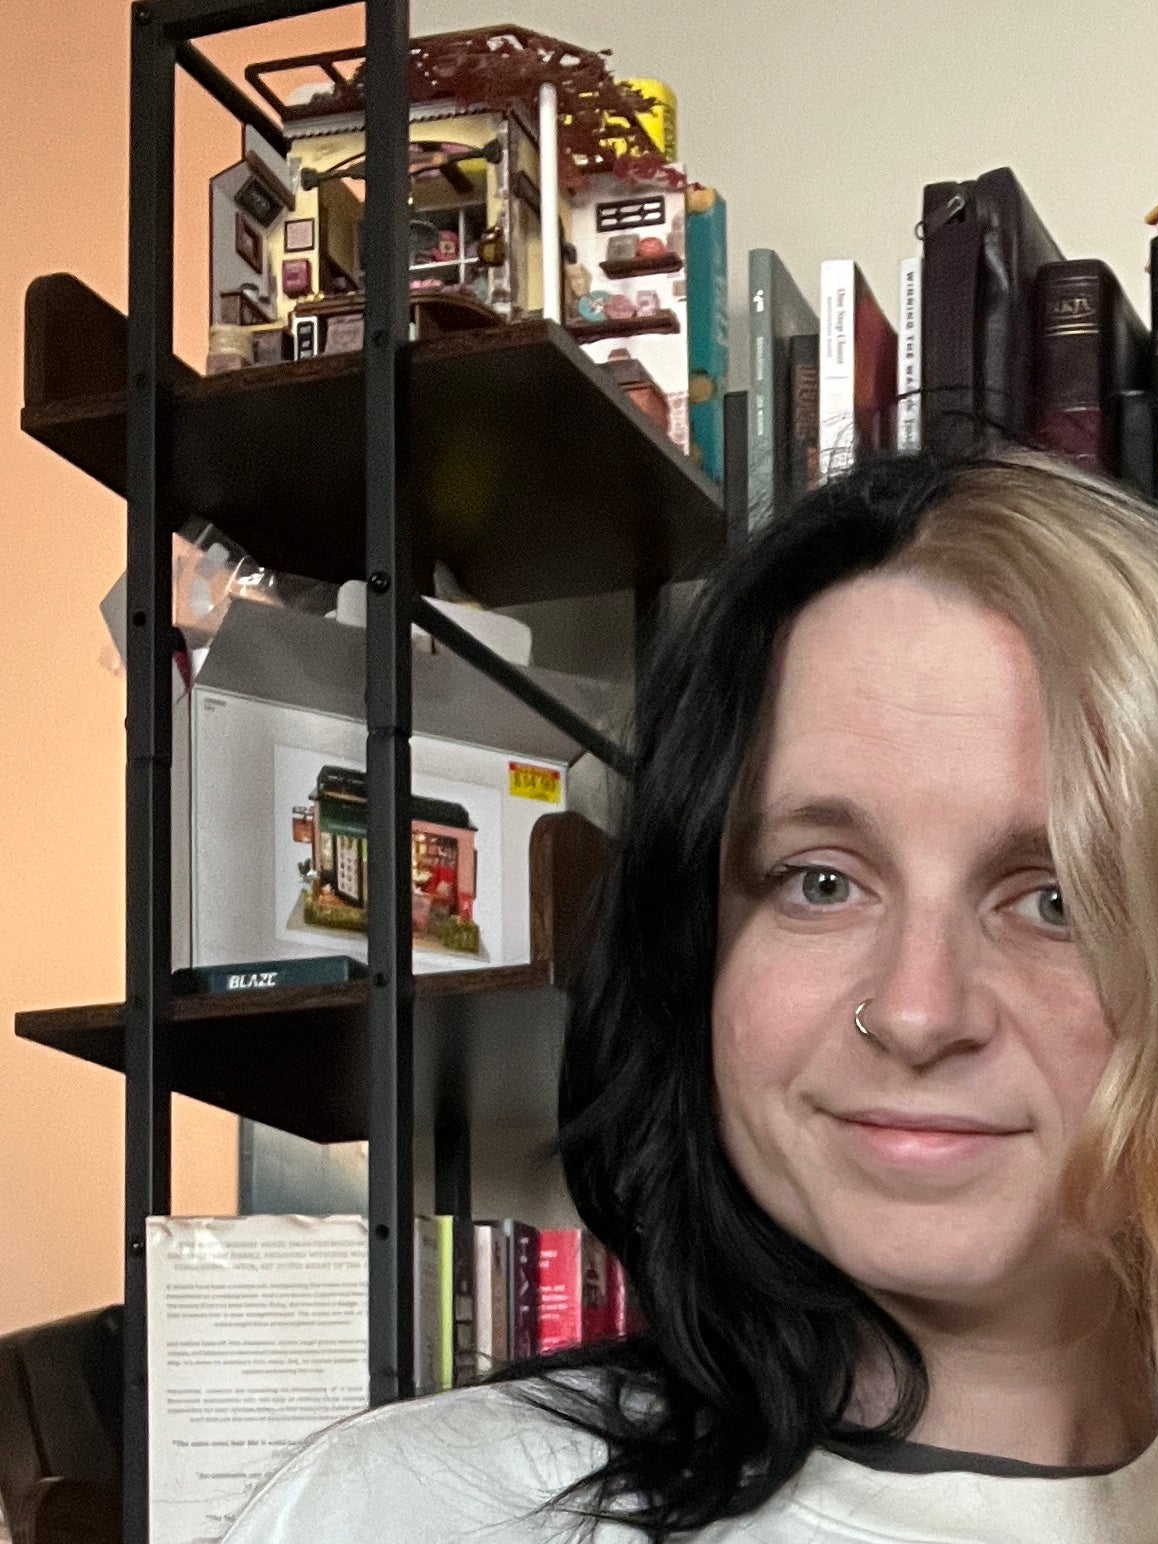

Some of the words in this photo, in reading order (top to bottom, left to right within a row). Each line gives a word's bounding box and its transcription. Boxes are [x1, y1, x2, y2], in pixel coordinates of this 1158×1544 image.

[836, 287, 847, 309] One
[905, 271, 916, 330] WINNING
[835, 310, 848, 332] Step
[836, 334, 847, 365] Closer
[905, 335, 915, 360] THE
